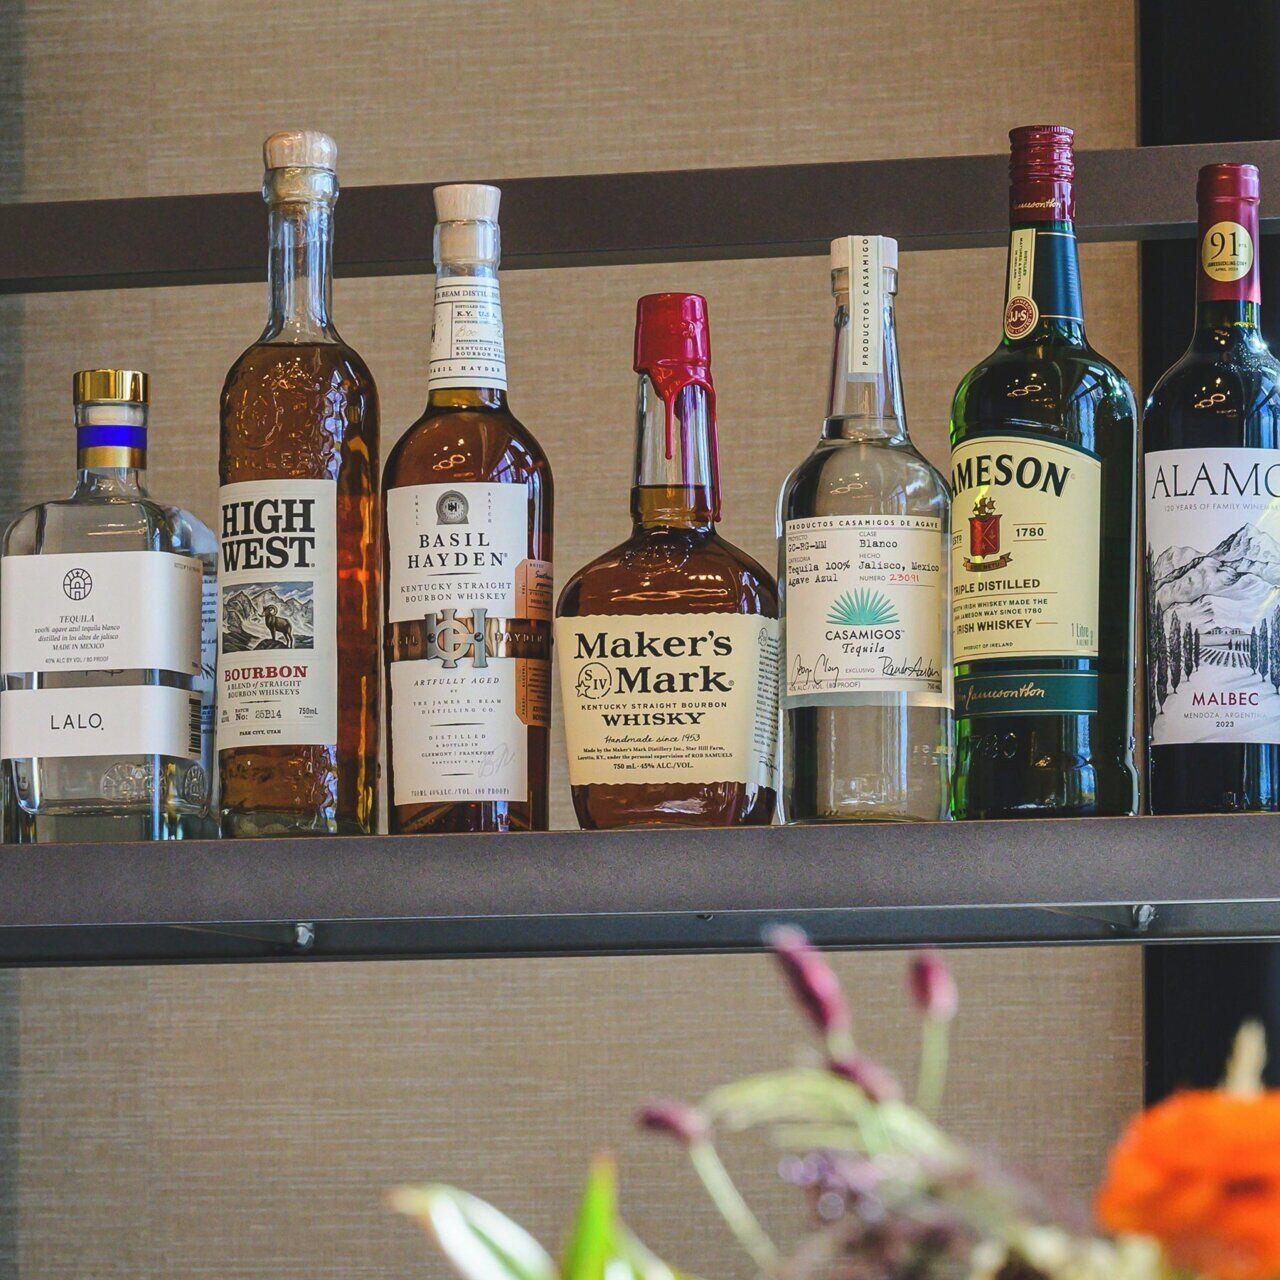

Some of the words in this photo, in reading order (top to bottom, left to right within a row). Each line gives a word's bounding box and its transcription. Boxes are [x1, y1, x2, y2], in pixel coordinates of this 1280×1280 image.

[1211, 232, 1239, 260] 91
[952, 454, 1071, 498] AMESON
[222, 499, 315, 538] HIGH
[789, 521, 833, 530] PRODUCTOS
[1016, 527, 1044, 537] 1780
[419, 533, 489, 548] BASIL
[859, 540, 897, 548] Blanco
[222, 536, 315, 572] WEST
[408, 552, 504, 569] HAYDEN
[858, 561, 905, 571] Jalisco,
[912, 562, 939, 572] Mexico
[789, 564, 819, 575] Tequila
[826, 561, 850, 570] 100%
[789, 578, 809, 587] Agave
[890, 573, 919, 582] 23091
[401, 583, 452, 593] KENTUCKY
[954, 583, 975, 595] TRIPLE
[978, 579, 1040, 591] DISTILLED
[406, 594, 452, 602] BOURBON
[60, 615, 95, 624] TEQUILA
[961, 611, 982, 619] JAMESON
[957, 623, 974, 635] IRISH
[977, 619, 1032, 631] WHISKEY
[826, 630, 901, 641] CASAMIGOS
[574, 630, 732, 659] Maker's
[842, 643, 884, 656] Tequila
[225, 666, 308, 682] BOURBON
[614, 666, 734, 694] Mark
[414, 678, 466, 686] ARTFULLY
[228, 690, 257, 699] BOURBON
[1192, 692, 1259, 706] MALBEC
[299, 707, 318, 715] 750mL
[601, 712, 705, 727] WHISKY
[604, 735, 654, 744] Handmade
